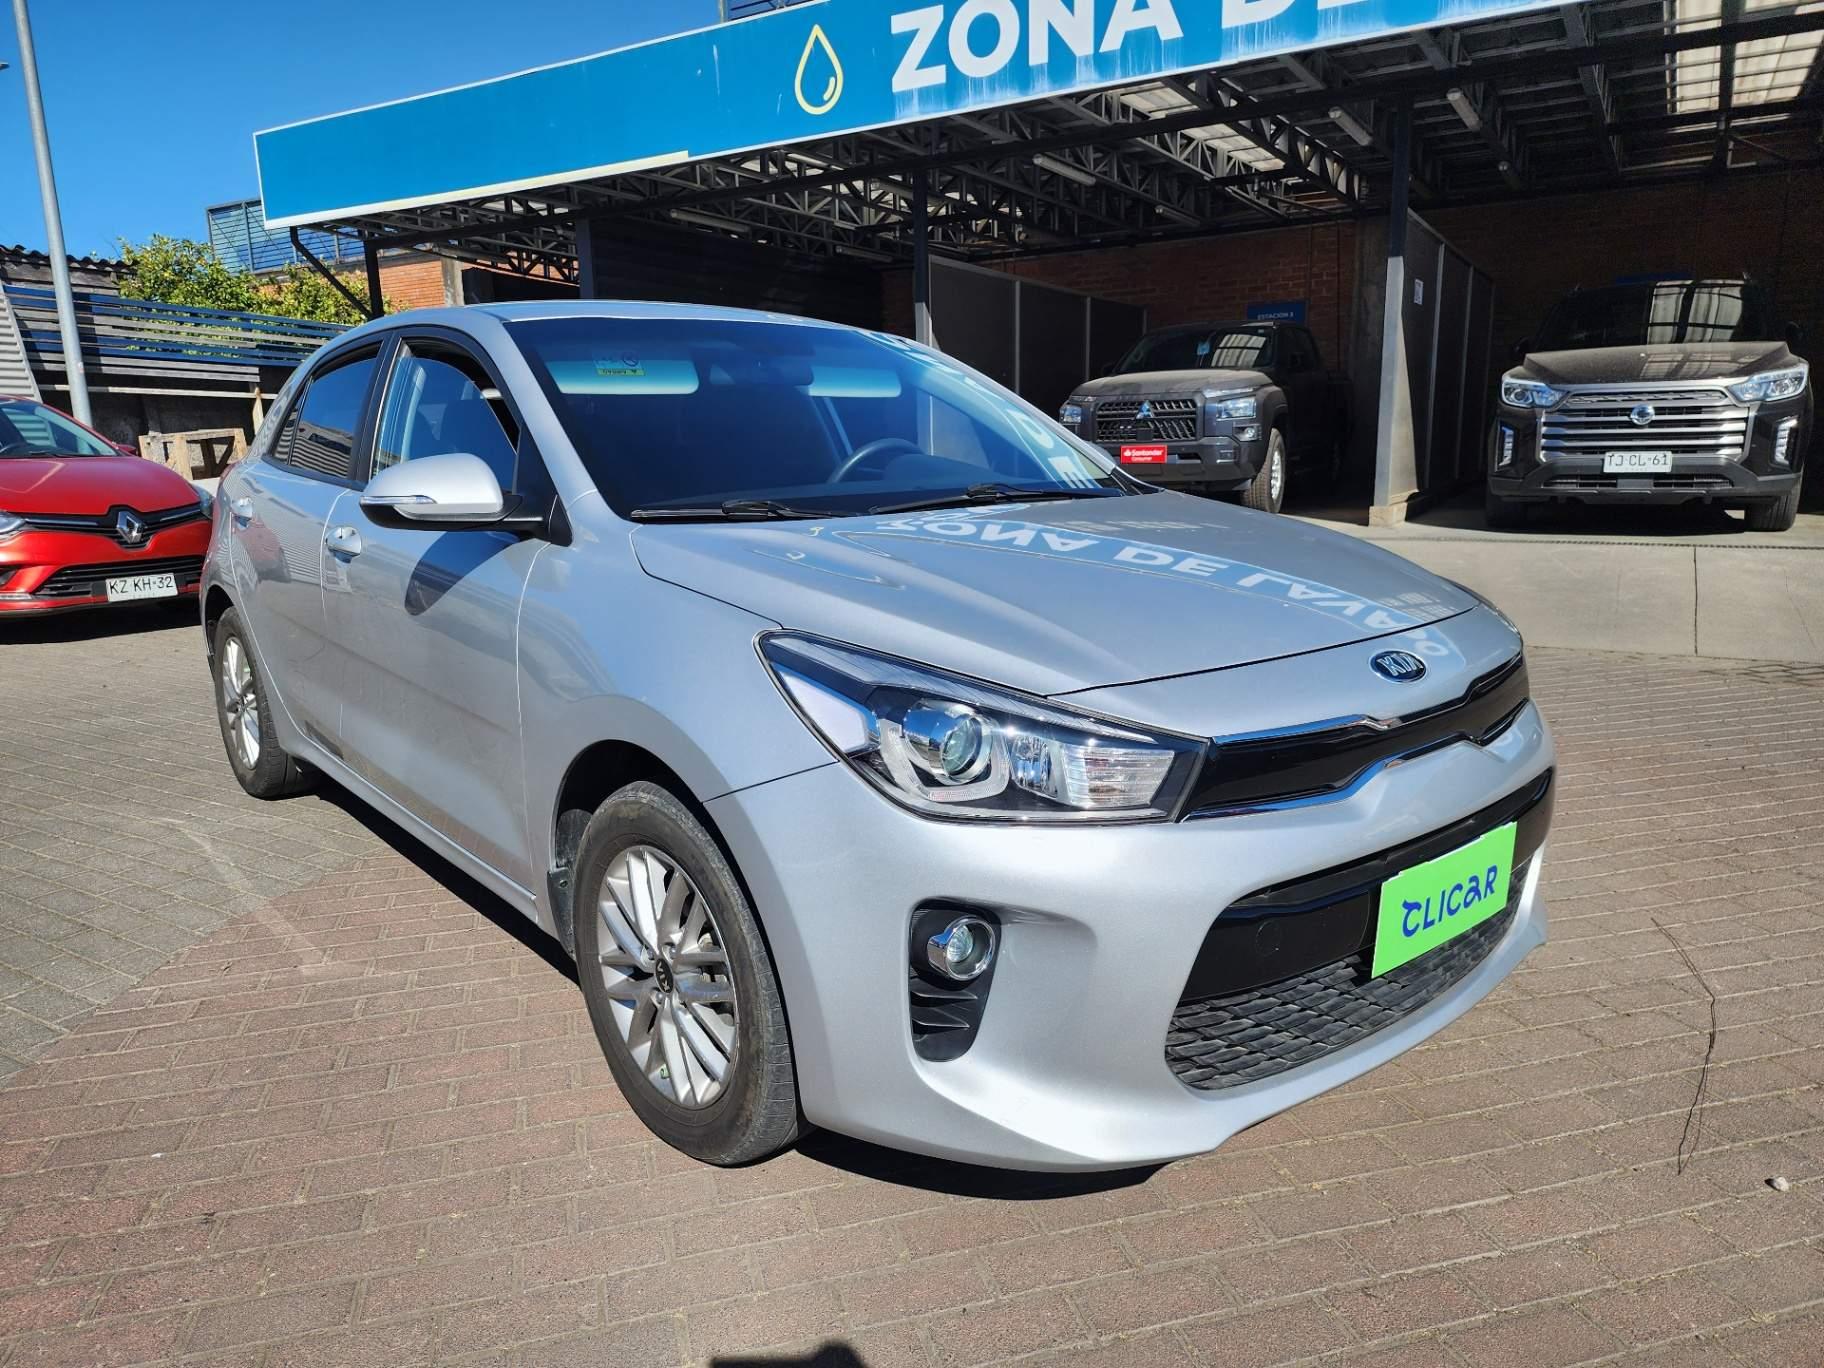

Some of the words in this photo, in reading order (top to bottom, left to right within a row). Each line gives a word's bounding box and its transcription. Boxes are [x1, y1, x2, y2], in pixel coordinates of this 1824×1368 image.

[891, 0, 1184, 93] ZONA
[1131, 449, 1164, 457] Santander
[1376, 651, 1424, 677] KIA
